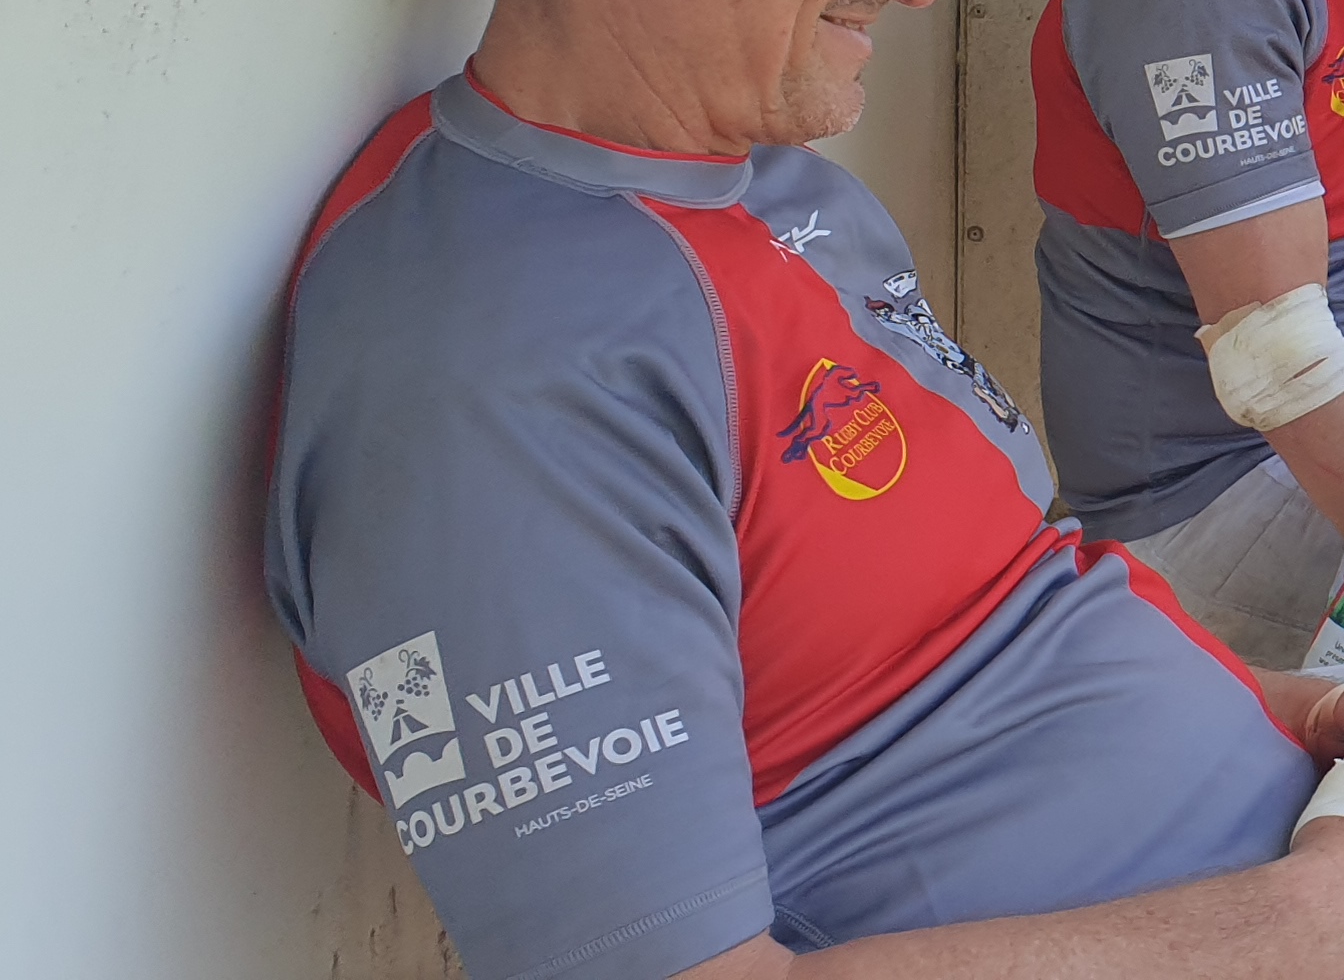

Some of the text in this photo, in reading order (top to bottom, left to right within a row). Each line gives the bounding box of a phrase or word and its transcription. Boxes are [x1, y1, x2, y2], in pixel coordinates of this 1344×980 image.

[1223, 78, 1282, 107] VILLE
[1229, 106, 1263, 129] DE
[1157, 115, 1306, 167] COURBEVOIE
[821, 419, 862, 455] RUGBY
[465, 649, 612, 724] VILLE
[483, 721, 558, 769] DE
[396, 709, 689, 856] COURBEVOIE
[514, 773, 654, 838] HAUTS-DE-SEINE
